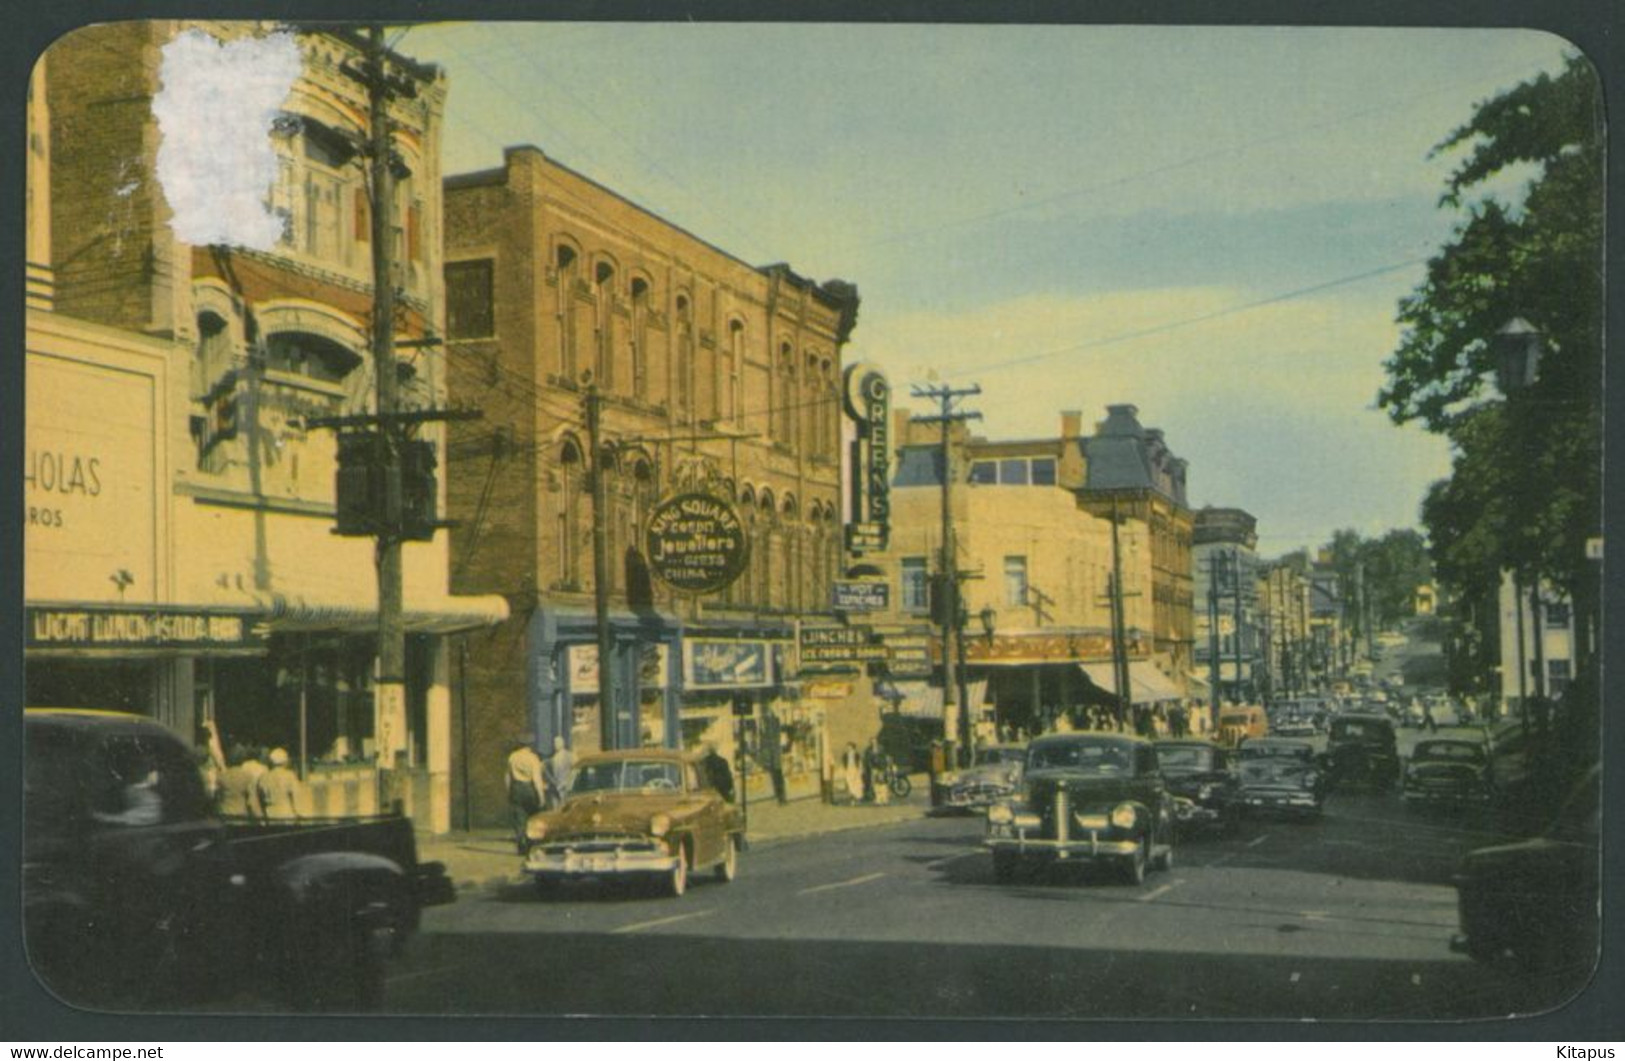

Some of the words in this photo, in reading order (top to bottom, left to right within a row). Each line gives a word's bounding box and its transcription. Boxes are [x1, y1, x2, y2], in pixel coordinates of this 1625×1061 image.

[870, 377, 886, 519] GREENS
[25, 506, 63, 528] ROS
[681, 499, 739, 531] SQUARE
[664, 567, 708, 580] CHINA
